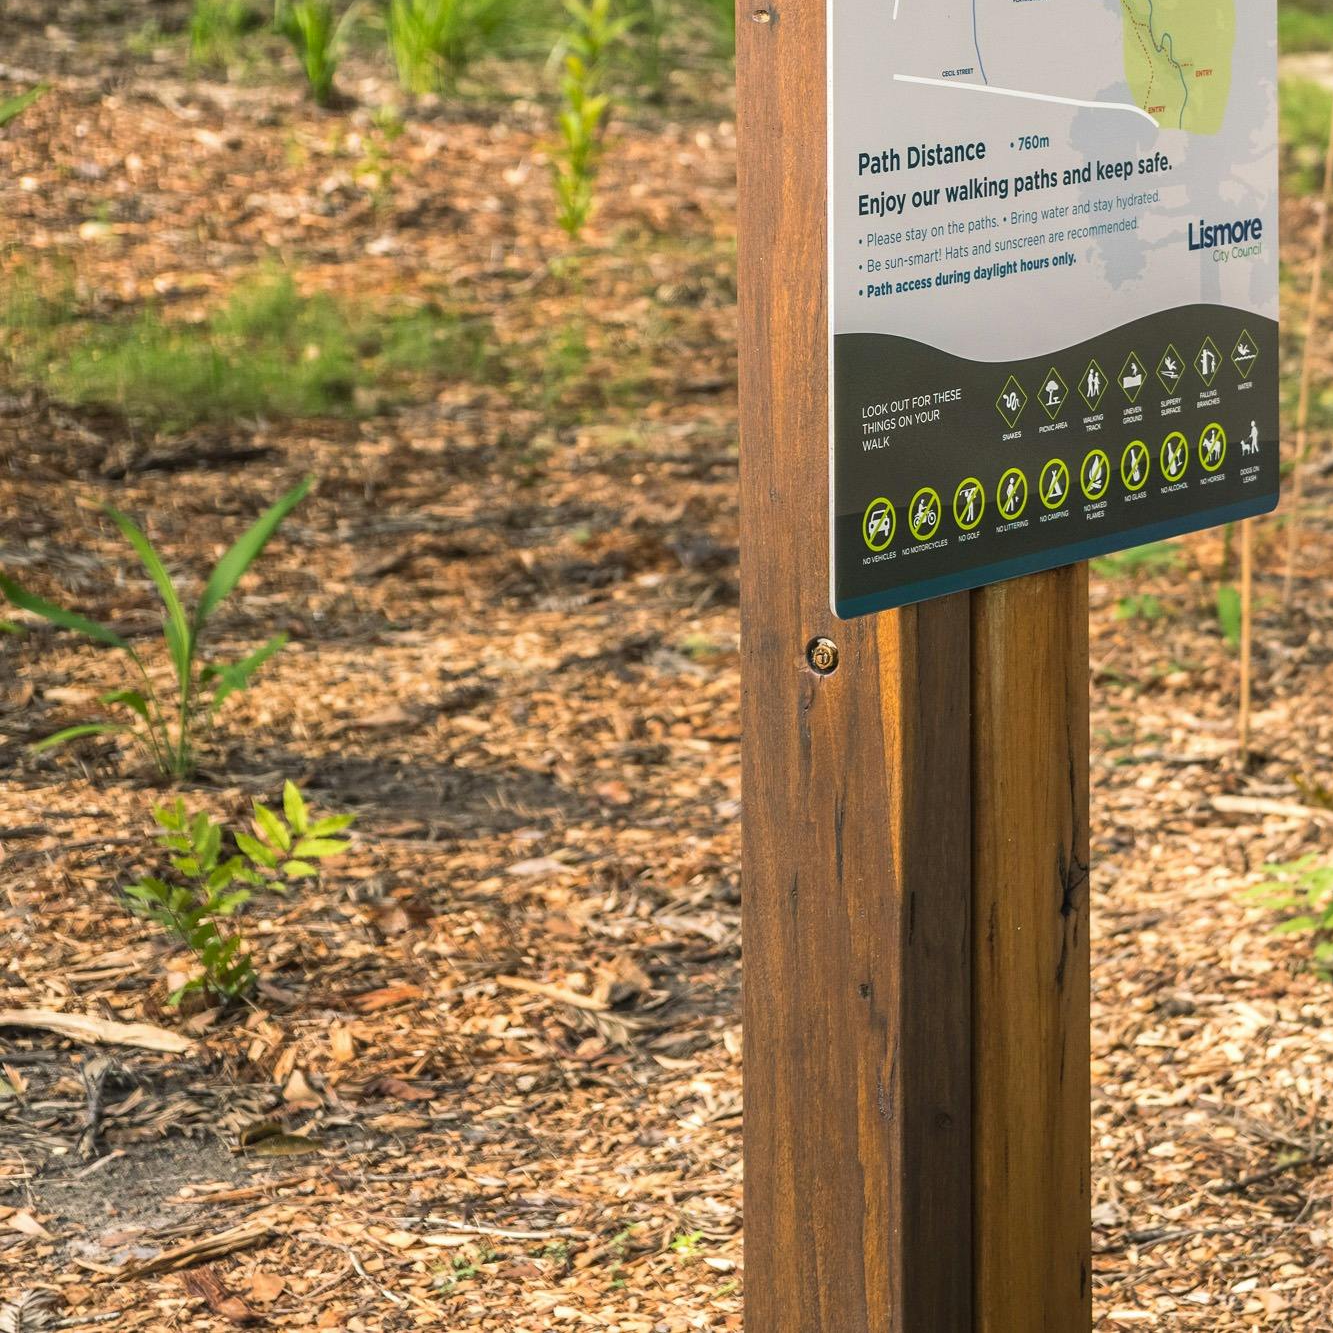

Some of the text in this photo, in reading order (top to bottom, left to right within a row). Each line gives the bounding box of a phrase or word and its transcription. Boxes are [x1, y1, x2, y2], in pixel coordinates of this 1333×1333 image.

[1195, 69, 1213, 77] ENTRY
[1148, 106, 1166, 114] ENTRY
[1018, 135, 1049, 151] 760m
[858, 141, 986, 176] Path Distance
[858, 151, 1172, 217] Enjoy our walking paths and keep safe.
[867, 190, 1160, 247] Please stay on the paths. Bring water and stay hydrated.
[1188, 218, 1263, 251] Lismore
[867, 217, 1138, 273] Be sun-smart! Hats and sunscreen are recommended.
[1212, 242, 1262, 263] City Council
[867, 251, 1077, 298] Path access during daylight hours only.
[862, 388, 962, 418] LOOK OUT FOR THESE
[862, 409, 940, 435] THINGS ON YOUR
[1083, 414, 1104, 424] WALKING
[1122, 414, 1143, 424] GROUND
[1002, 430, 1022, 441] SNAKES
[1086, 423, 1101, 432] TRACK
[862, 436, 890, 451] WALK
[1004, 519, 1029, 531] LITTERING
[967, 531, 980, 540] GOLF
[902, 539, 948, 556] NO MOTORCYCLES
[863, 551, 897, 565] NO VEHICLES
